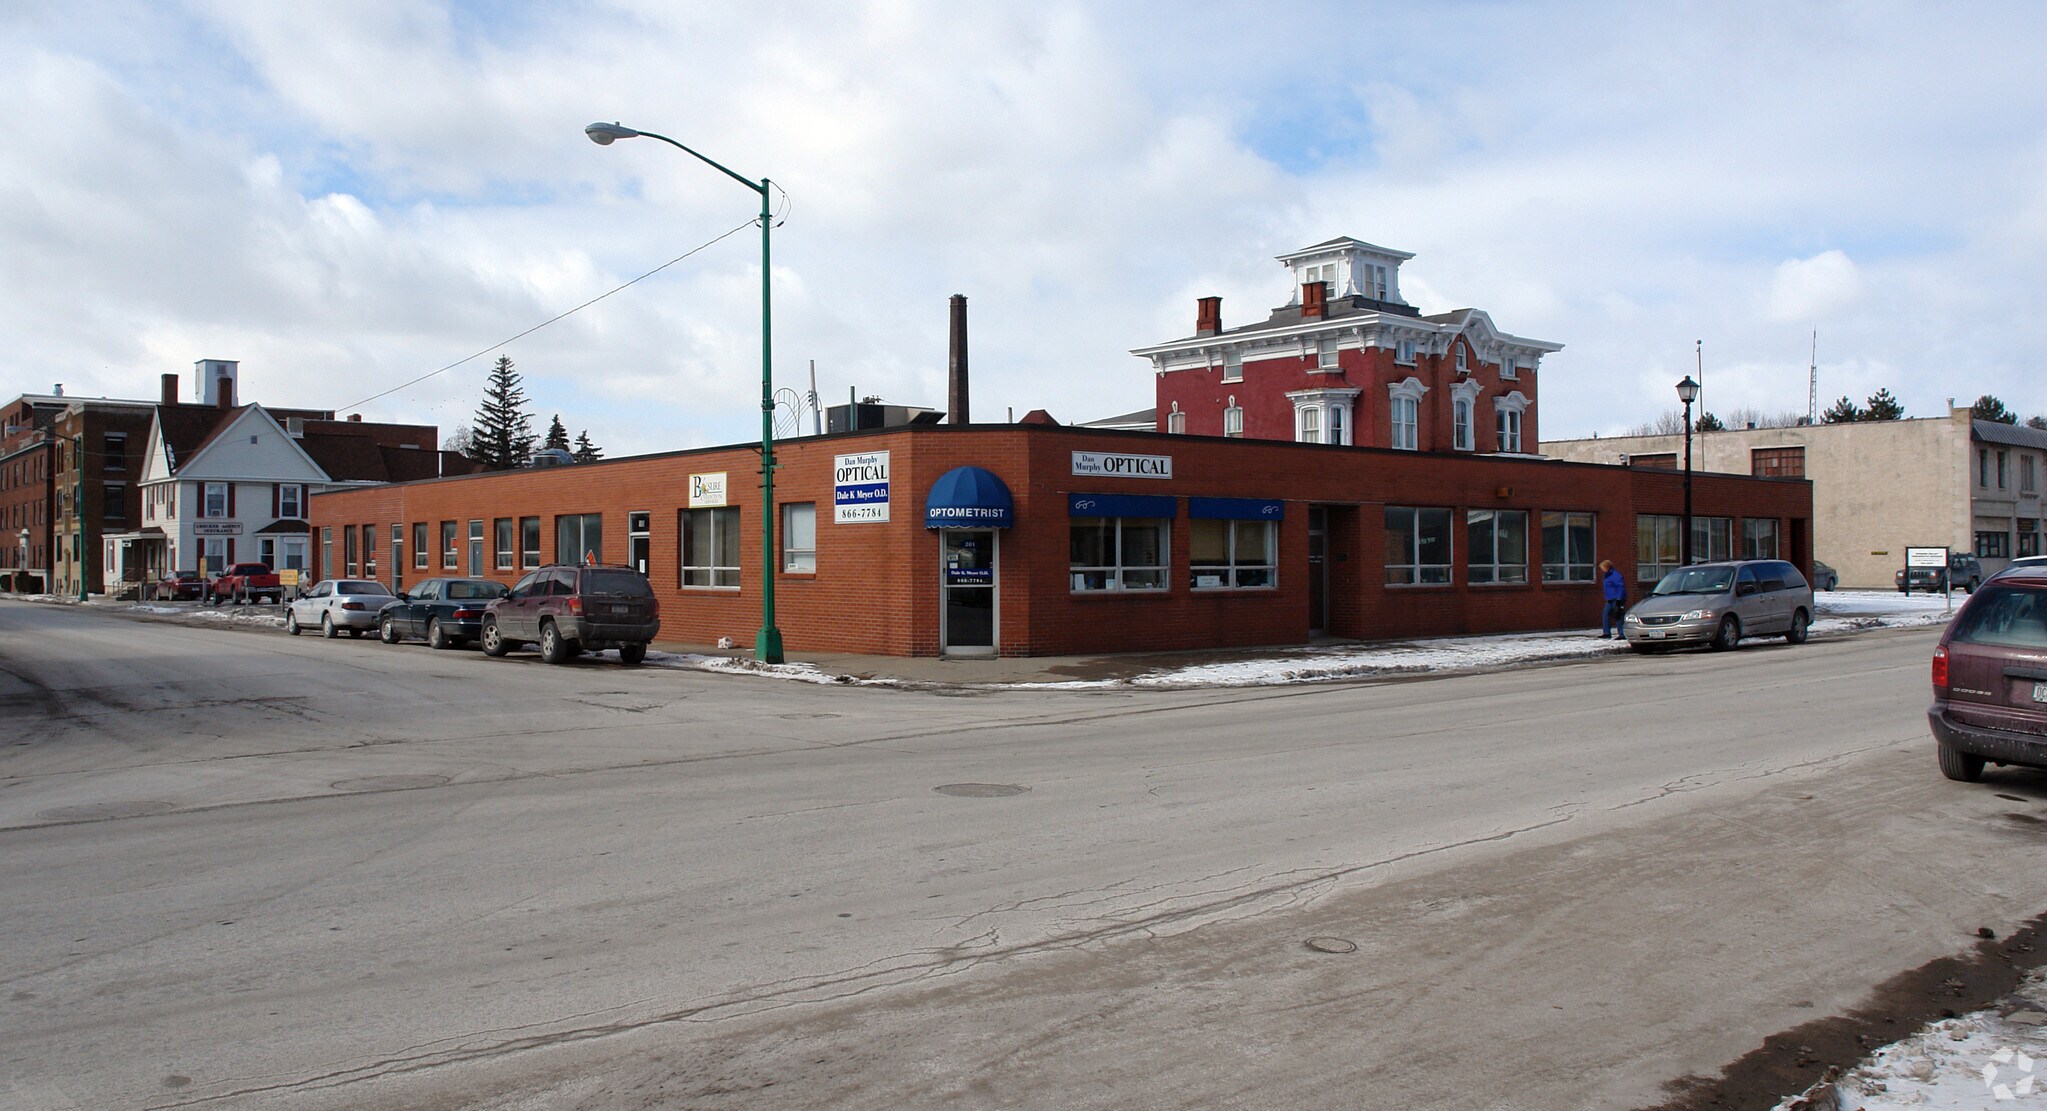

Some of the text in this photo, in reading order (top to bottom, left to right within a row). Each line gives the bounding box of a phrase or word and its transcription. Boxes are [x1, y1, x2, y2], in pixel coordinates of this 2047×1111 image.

[845, 455, 878, 466] Dan Murphy
[1082, 454, 1095, 462] Dan
[1075, 462, 1101, 473] Murphy
[1103, 456, 1169, 475] OPTICAL
[836, 464, 888, 483] OPTICAL
[836, 491, 849, 500] Dale
[856, 489, 873, 501] Meyer
[874, 488, 888, 498] O.D.
[841, 508, 882, 519] 866-7784
[930, 507, 1005, 518] OPTOMETRIST
[1952, 687, 1992, 696] DODGE
